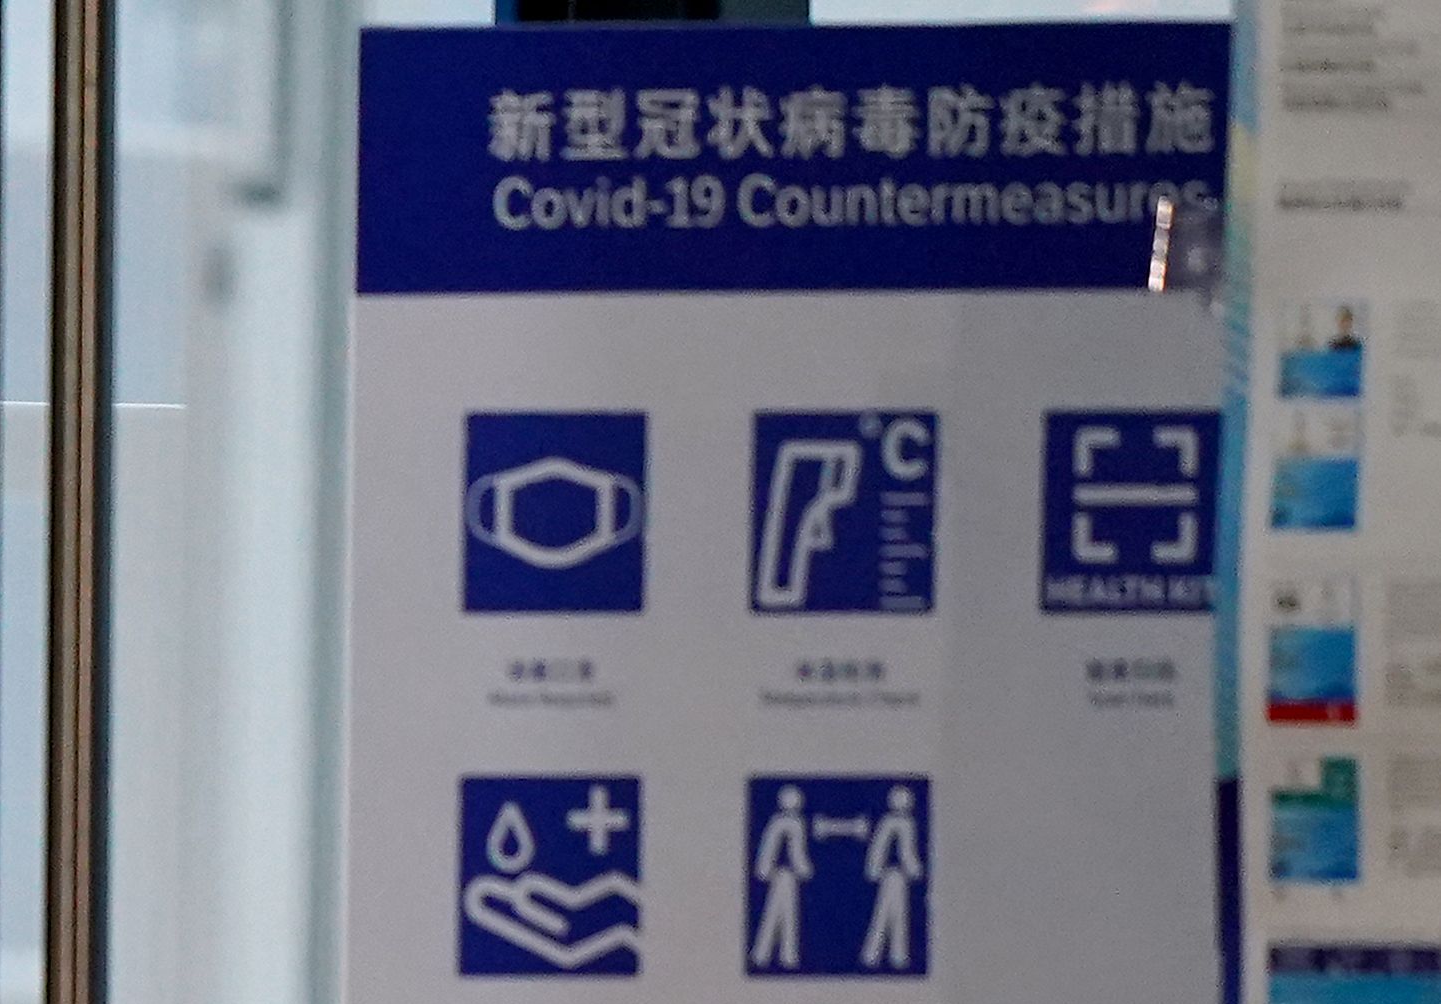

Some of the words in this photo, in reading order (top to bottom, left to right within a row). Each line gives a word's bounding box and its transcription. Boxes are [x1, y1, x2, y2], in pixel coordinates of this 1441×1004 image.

[490, 83, 1214, 159] 新型冠状病毒防疫措施
[494, 176, 724, 230] Covid-19
